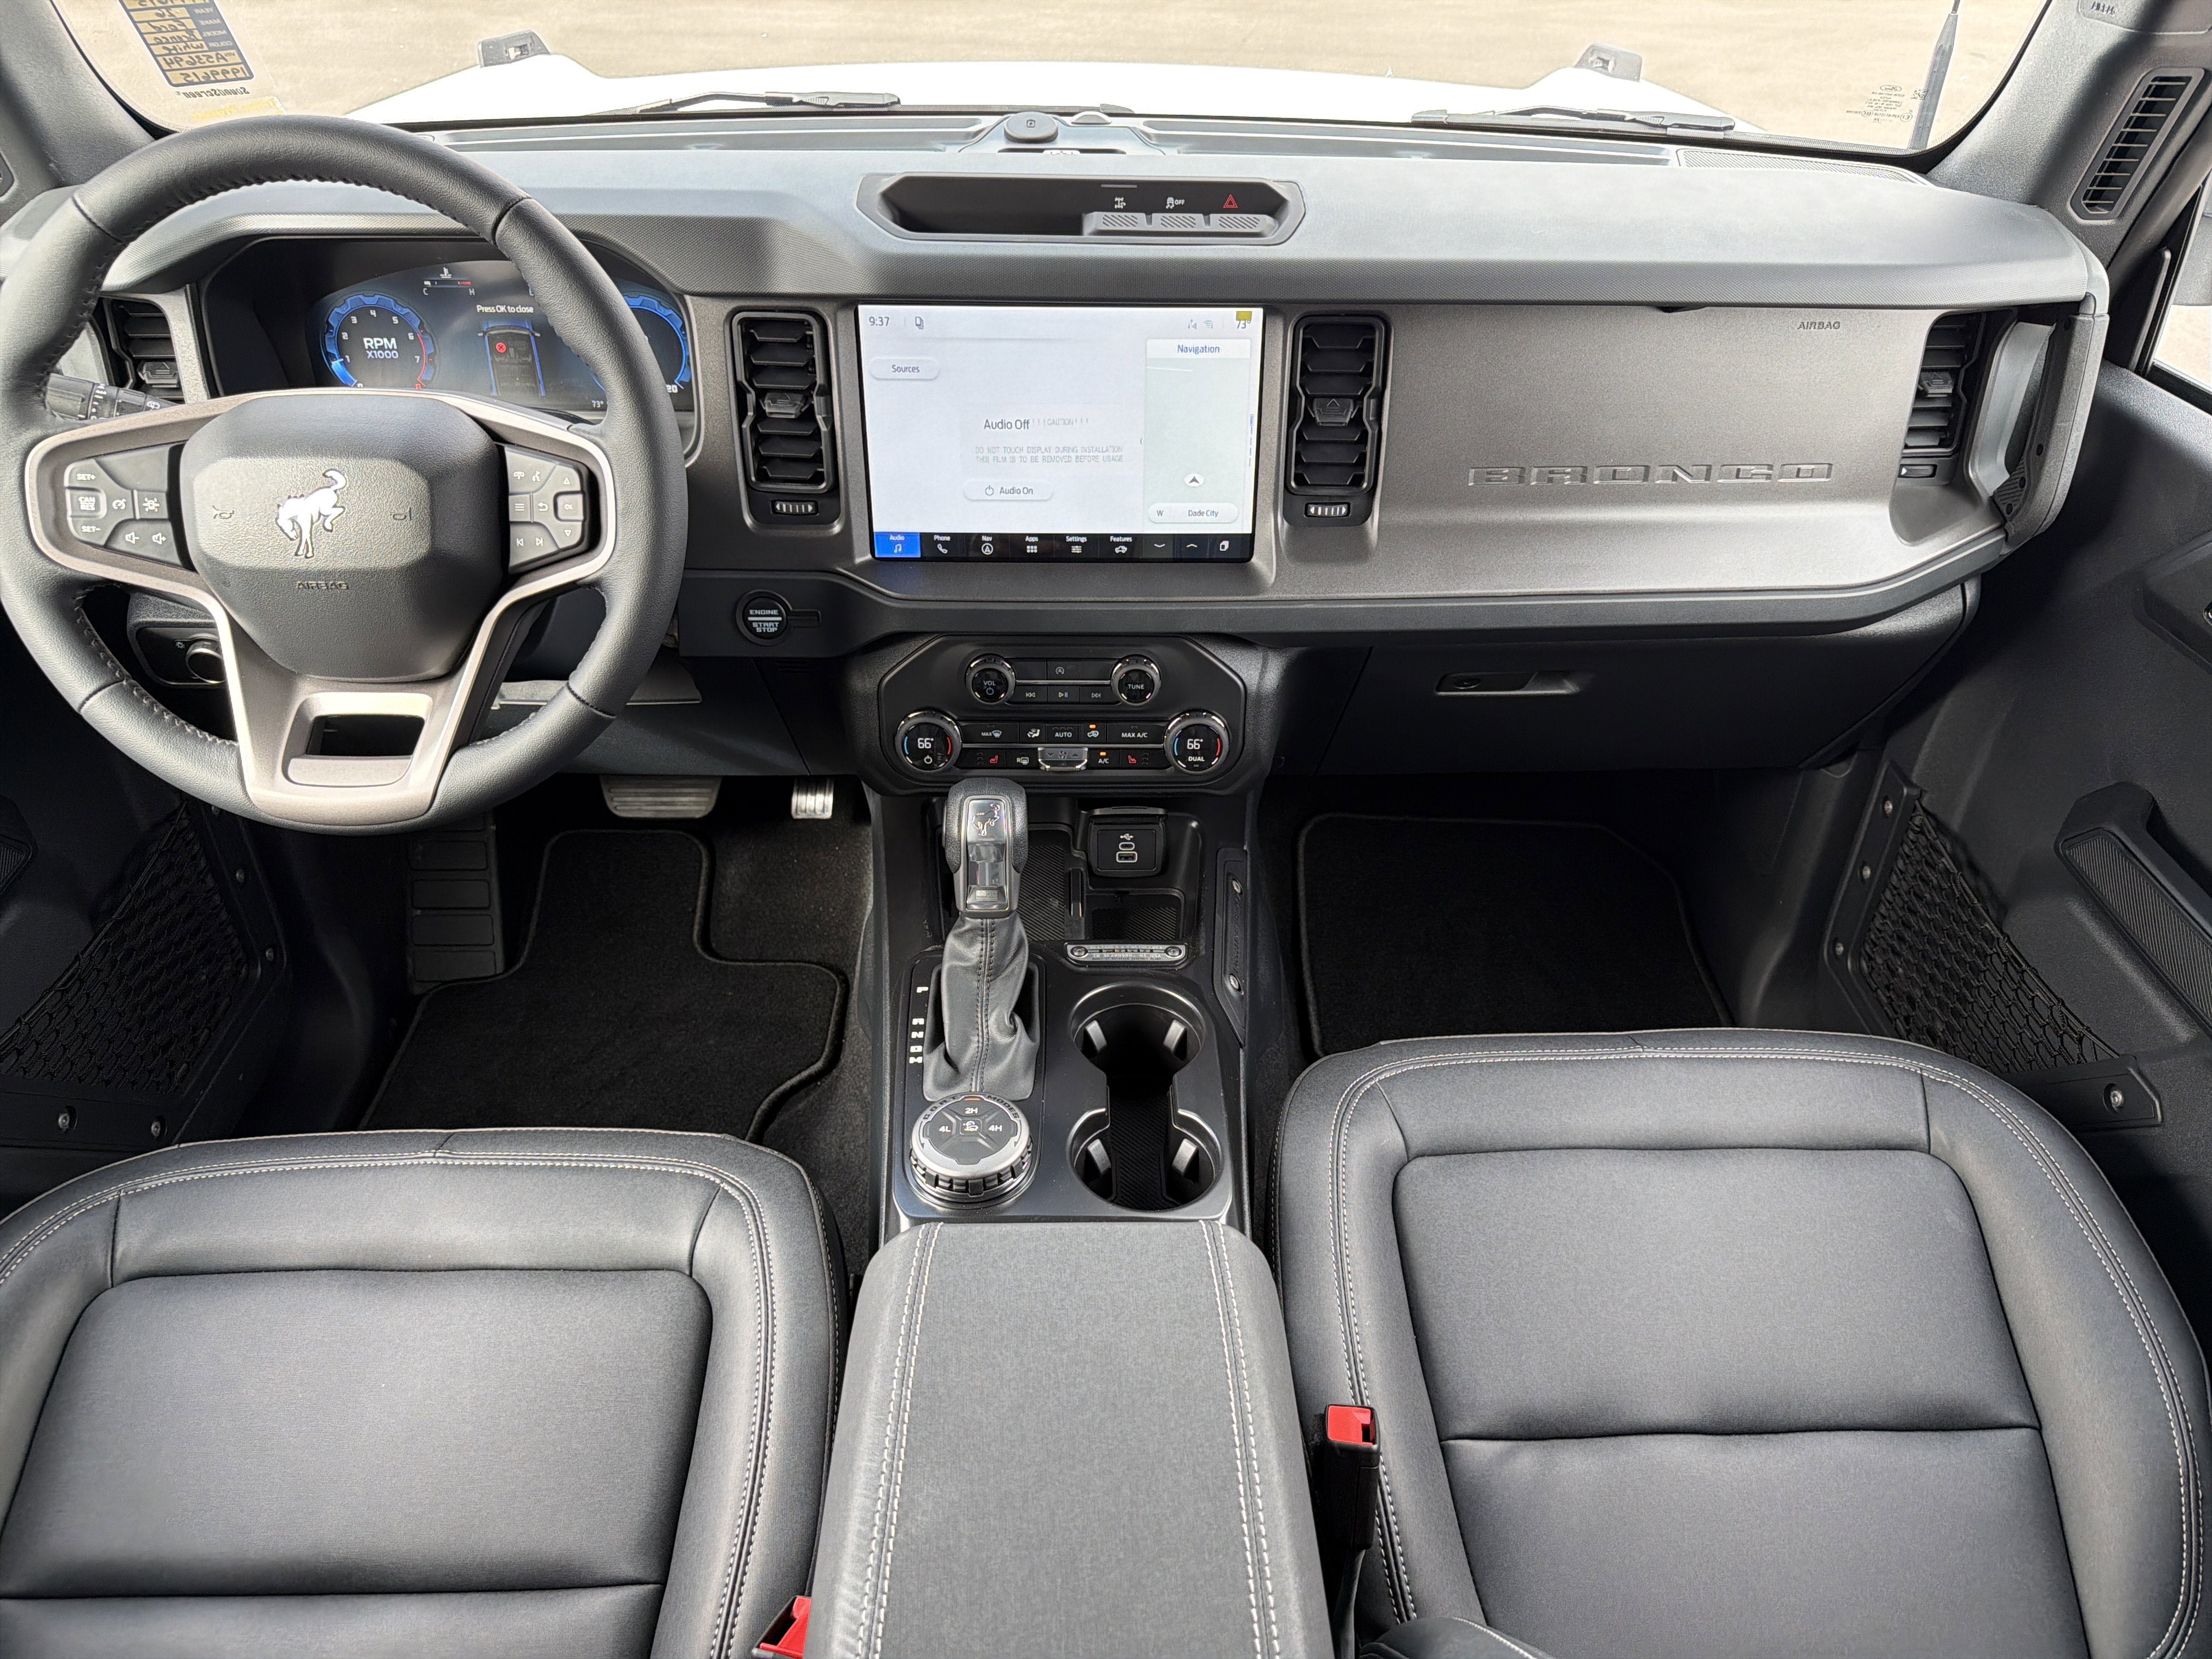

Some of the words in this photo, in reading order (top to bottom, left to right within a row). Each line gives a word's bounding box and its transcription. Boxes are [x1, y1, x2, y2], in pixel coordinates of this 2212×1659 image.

[476, 304, 496, 313] Press
[496, 305, 507, 313] OK
[516, 305, 534, 313] close
[370, 309, 377, 318] 4
[351, 316, 358, 324] 3
[392, 316, 399, 325] 5
[868, 316, 890, 326] 9:37
[1797, 320, 1841, 331] AIRBAG
[342, 332, 349, 340] 2
[363, 337, 397, 350] RPM
[1177, 345, 1220, 354] Navigation
[366, 350, 399, 359] X1000
[891, 364, 920, 373] Sources
[984, 419, 1013, 430] Audio
[1015, 419, 1030, 430] Off
[1081, 445, 1123, 453] INSTALLATION
[1468, 463, 1834, 487] BRONCO
[1000, 486, 1021, 495] Audio
[1023, 487, 1034, 495] On
[1206, 509, 1219, 518] City
[296, 580, 350, 590] AIRBAG
[988, 1095, 1020, 1119] MODES
